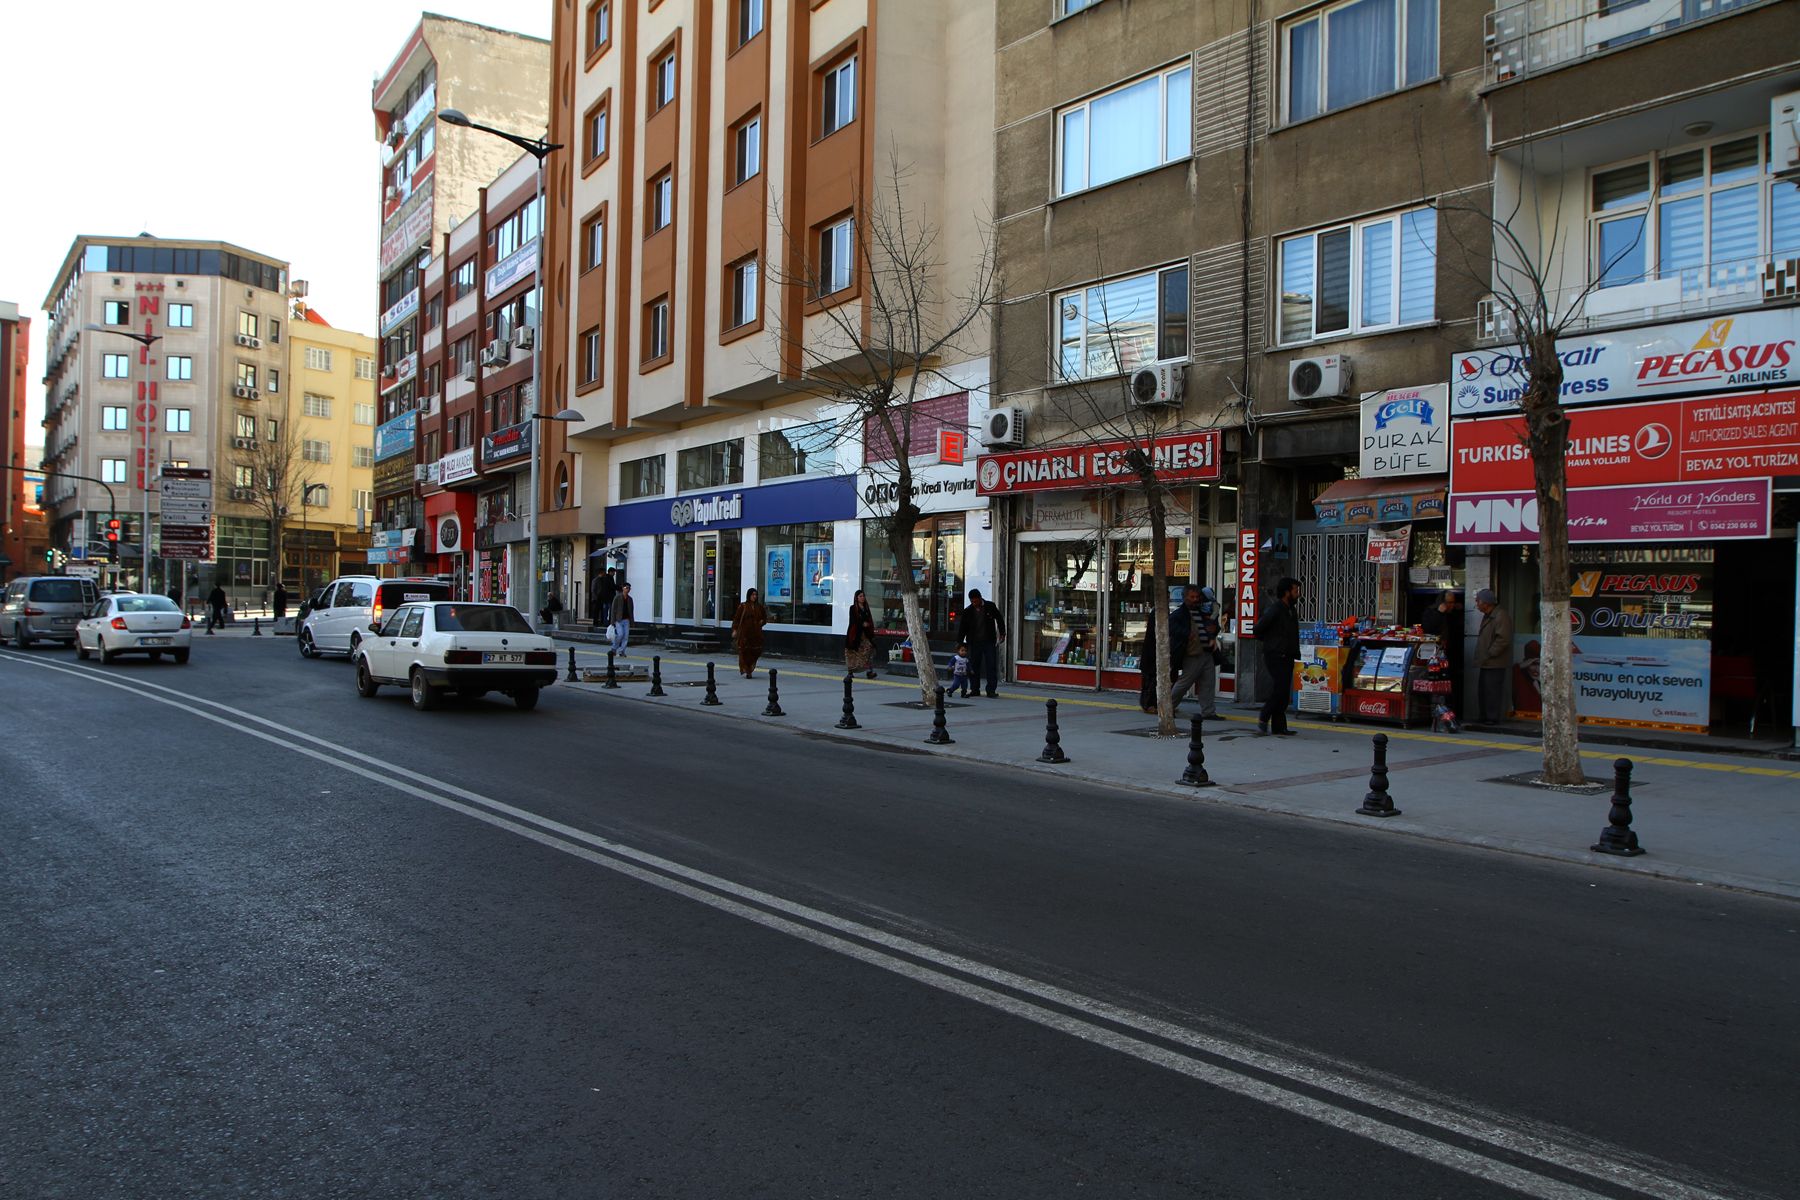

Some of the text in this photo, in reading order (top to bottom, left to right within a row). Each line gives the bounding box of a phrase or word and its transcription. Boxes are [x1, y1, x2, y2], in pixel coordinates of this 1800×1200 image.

[1637, 340, 1796, 379] PEGASUS
[1727, 369, 1788, 384] AIRLINES
[1386, 391, 1420, 402] ÜLKER
[1381, 400, 1426, 419] Golf
[1692, 398, 1796, 422] YETKİLİ SATIŞ ACENTESİ
[136, 381, 158, 490] HOTEL
[1363, 427, 1444, 451] DURAK
[1689, 422, 1798, 443] AUTHORIZED SALES AGENT
[946, 436, 958, 459] E
[1564, 435, 1631, 456] RLINES
[1374, 452, 1432, 472] BÜFE
[1567, 456, 1631, 467] HAVA YOLLARI
[1686, 452, 1799, 472] BEYAZ YOL TURİZM
[1003, 454, 1086, 490] ÇINARLI
[921, 481, 942, 495] Kredi
[1383, 503, 1404, 513] Golf
[1418, 499, 1439, 509] Golf
[1633, 490, 1672, 511] World
[1697, 487, 1756, 508] Wonders
[693, 493, 742, 526] YapıKredi
[1319, 509, 1338, 519] Golf
[1350, 506, 1370, 516] Golf
[1631, 524, 1649, 533] BEYAZ
[1650, 524, 1663, 532] YOL
[1241, 533, 1256, 635] ECZANE
[1600, 574, 1701, 593] PEGASUS
[1653, 595, 1691, 603] AIRLINES
[1591, 607, 1700, 629] Onurair
[511, 654, 522, 662] 577
[1618, 674, 1634, 684] en
[1636, 674, 1660, 686] çok
[1662, 676, 1703, 688] seven
[1580, 685, 1664, 704] havayoluyuz
